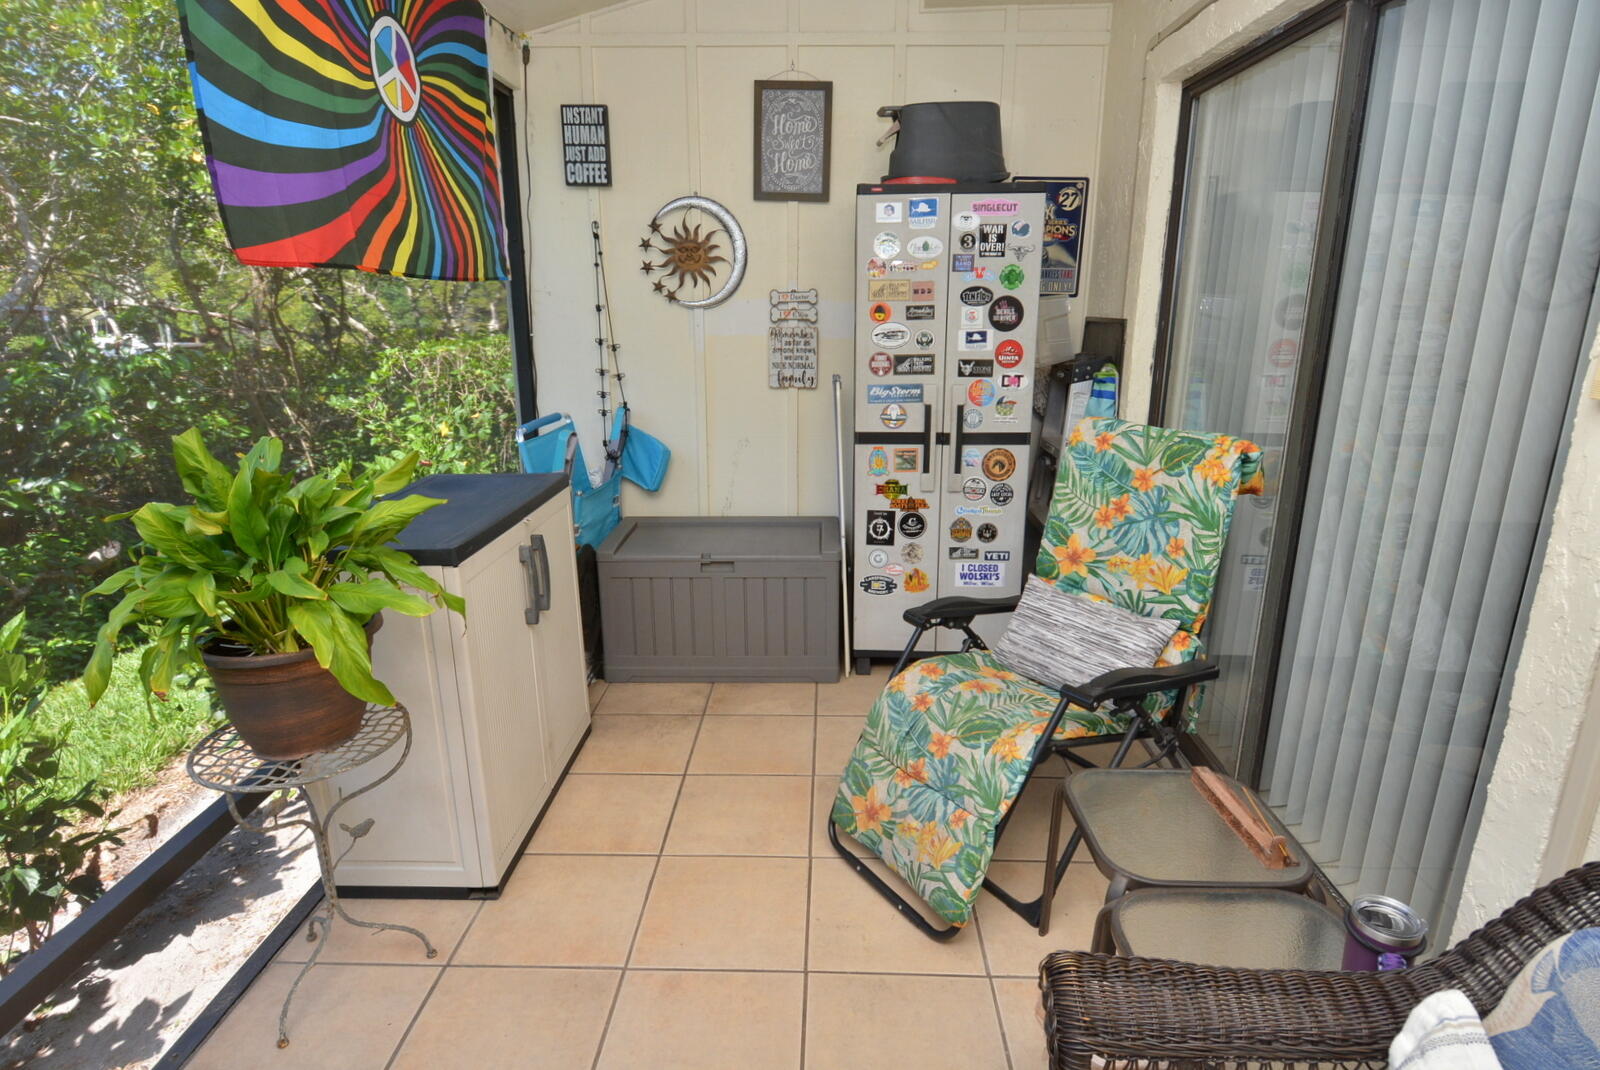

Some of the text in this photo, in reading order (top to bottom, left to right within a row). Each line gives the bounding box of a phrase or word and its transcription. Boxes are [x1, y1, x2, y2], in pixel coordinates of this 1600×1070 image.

[562, 107, 604, 124] INSTANT
[771, 112, 818, 135] Home
[564, 125, 606, 145] HUMAN
[772, 135, 815, 151] Sweet
[565, 145, 606, 162] JUST ADD
[773, 151, 817, 174] Home
[566, 163, 608, 183] COFFEE
[1061, 191, 1078, 208] 27
[982, 225, 1004, 234] WAR
[1045, 225, 1076, 237] PIONS
[963, 234, 973, 247] 3
[988, 234, 997, 243] IS
[980, 242, 1005, 252] OVER!
[963, 290, 976, 301] TEN
[985, 552, 1009, 560] YETI
[961, 563, 999, 573] I CLOSED
[959, 572, 1000, 581] WOLSKI'S
